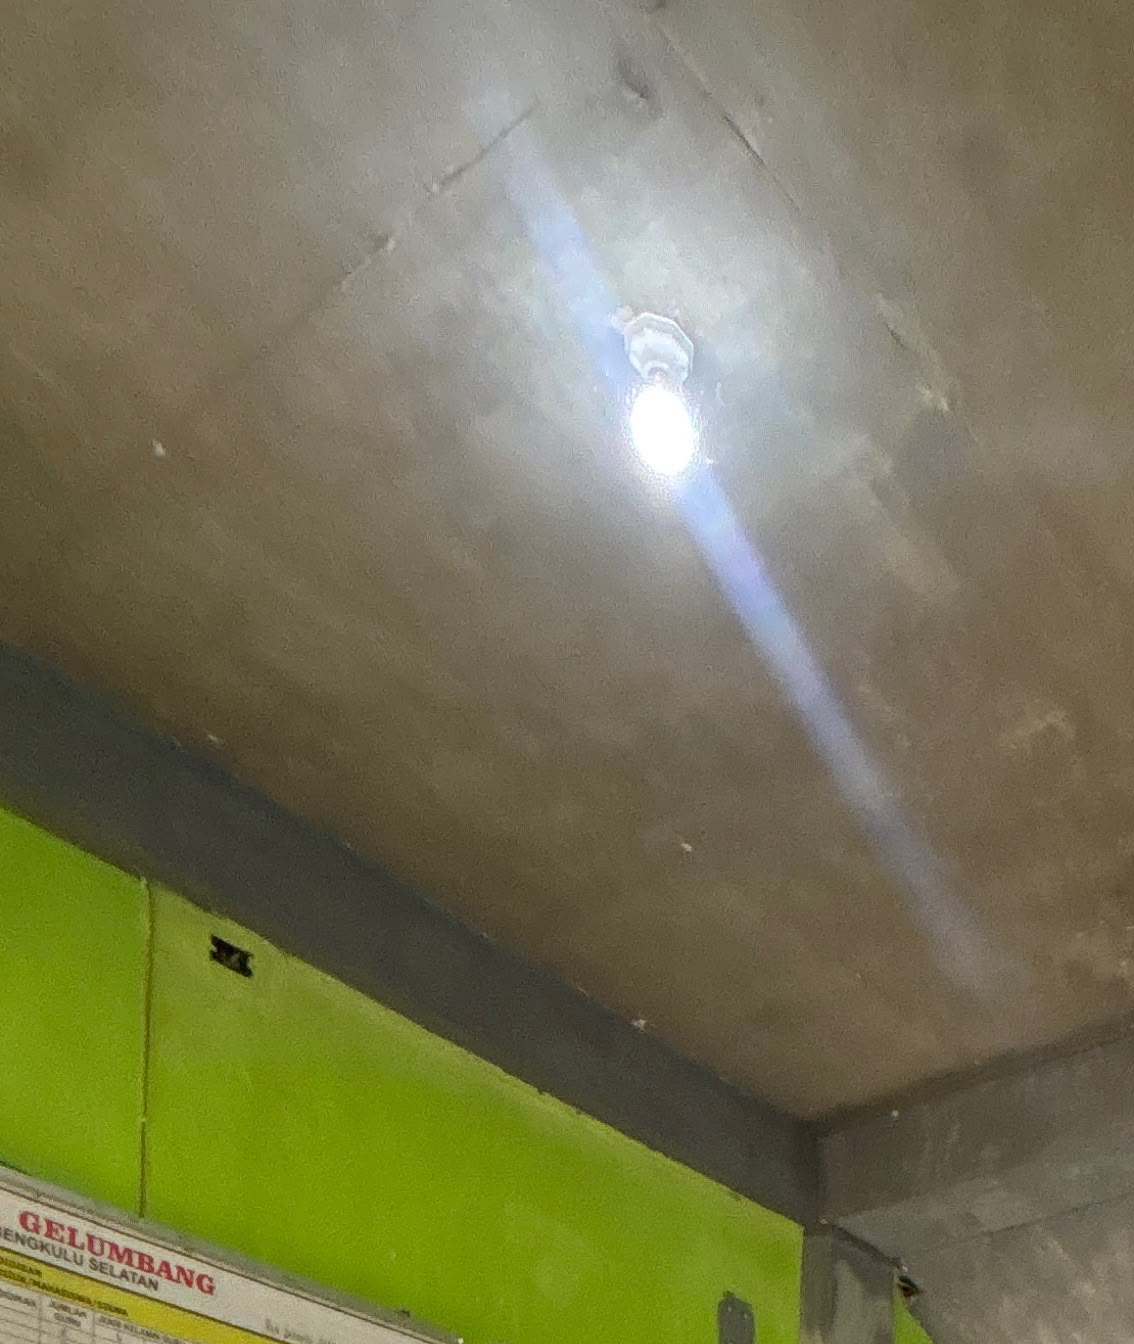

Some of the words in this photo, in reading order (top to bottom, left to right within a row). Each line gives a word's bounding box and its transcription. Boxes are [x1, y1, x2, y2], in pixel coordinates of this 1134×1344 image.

[0, 1226, 84, 1266] ENGKULU
[88, 1257, 159, 1292] SELATAN
[18, 1210, 216, 1296] GELUMBANG
